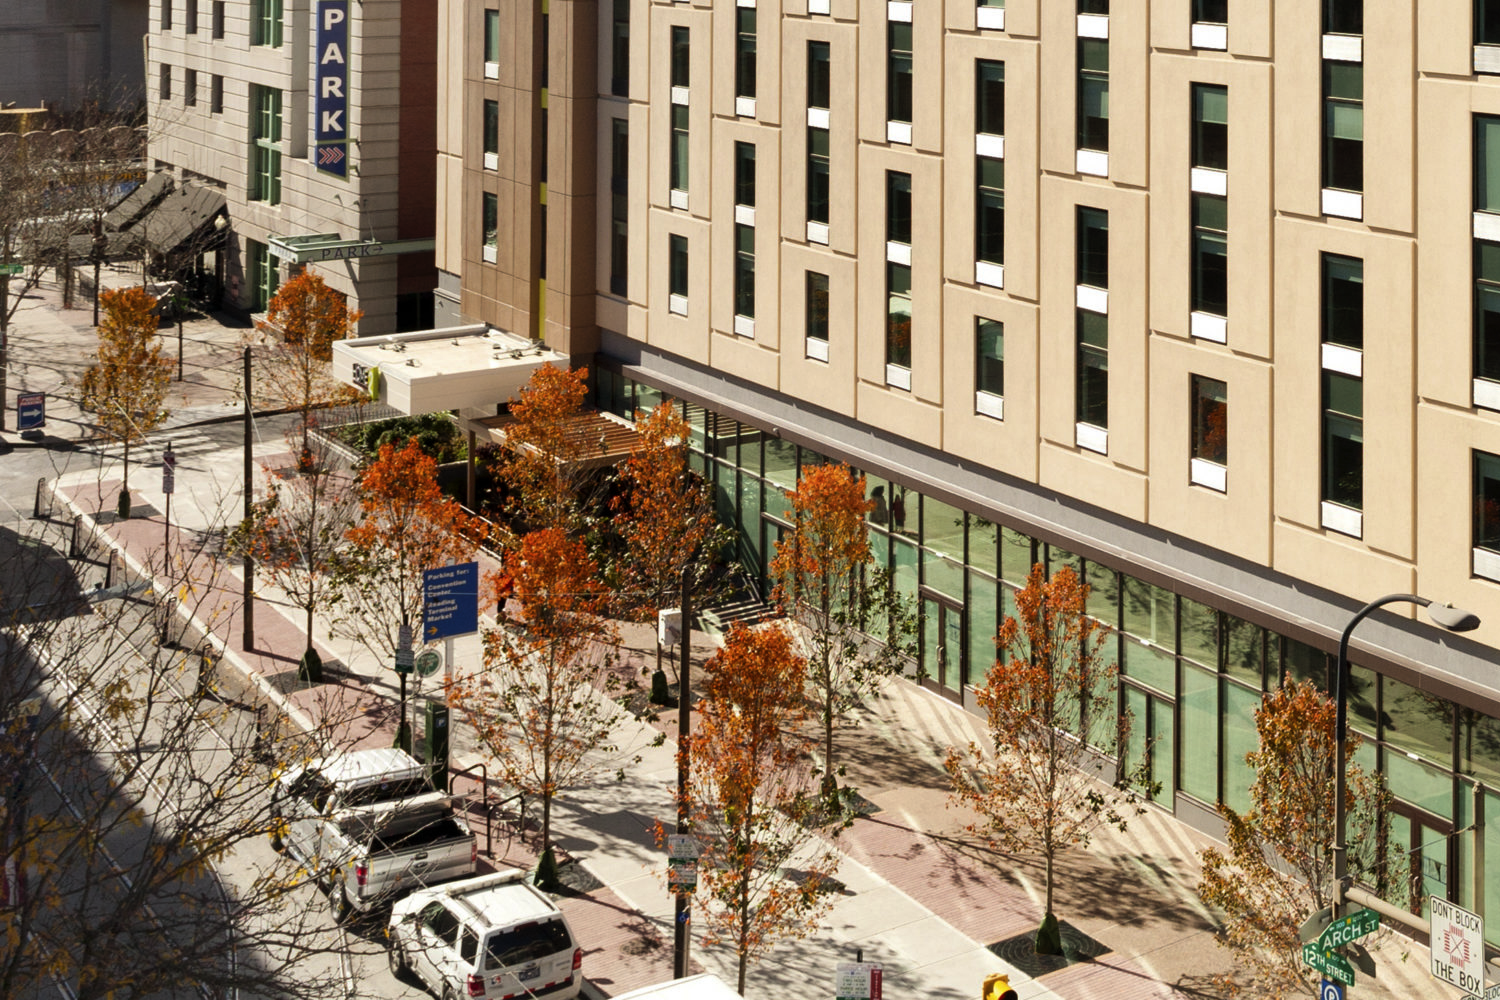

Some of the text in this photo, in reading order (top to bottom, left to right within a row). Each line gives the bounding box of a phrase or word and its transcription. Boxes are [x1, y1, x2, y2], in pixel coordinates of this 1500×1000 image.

[321, 8, 345, 133] PARK
[321, 245, 371, 260] PARK
[428, 580, 467, 590] Convention
[1322, 920, 1377, 951] ARCH ST
[1456, 910, 1481, 934] BLOCK
[1304, 948, 1326, 967] 12TH
[1326, 963, 1353, 985] STREET
[1434, 959, 1481, 995] THE BOX
